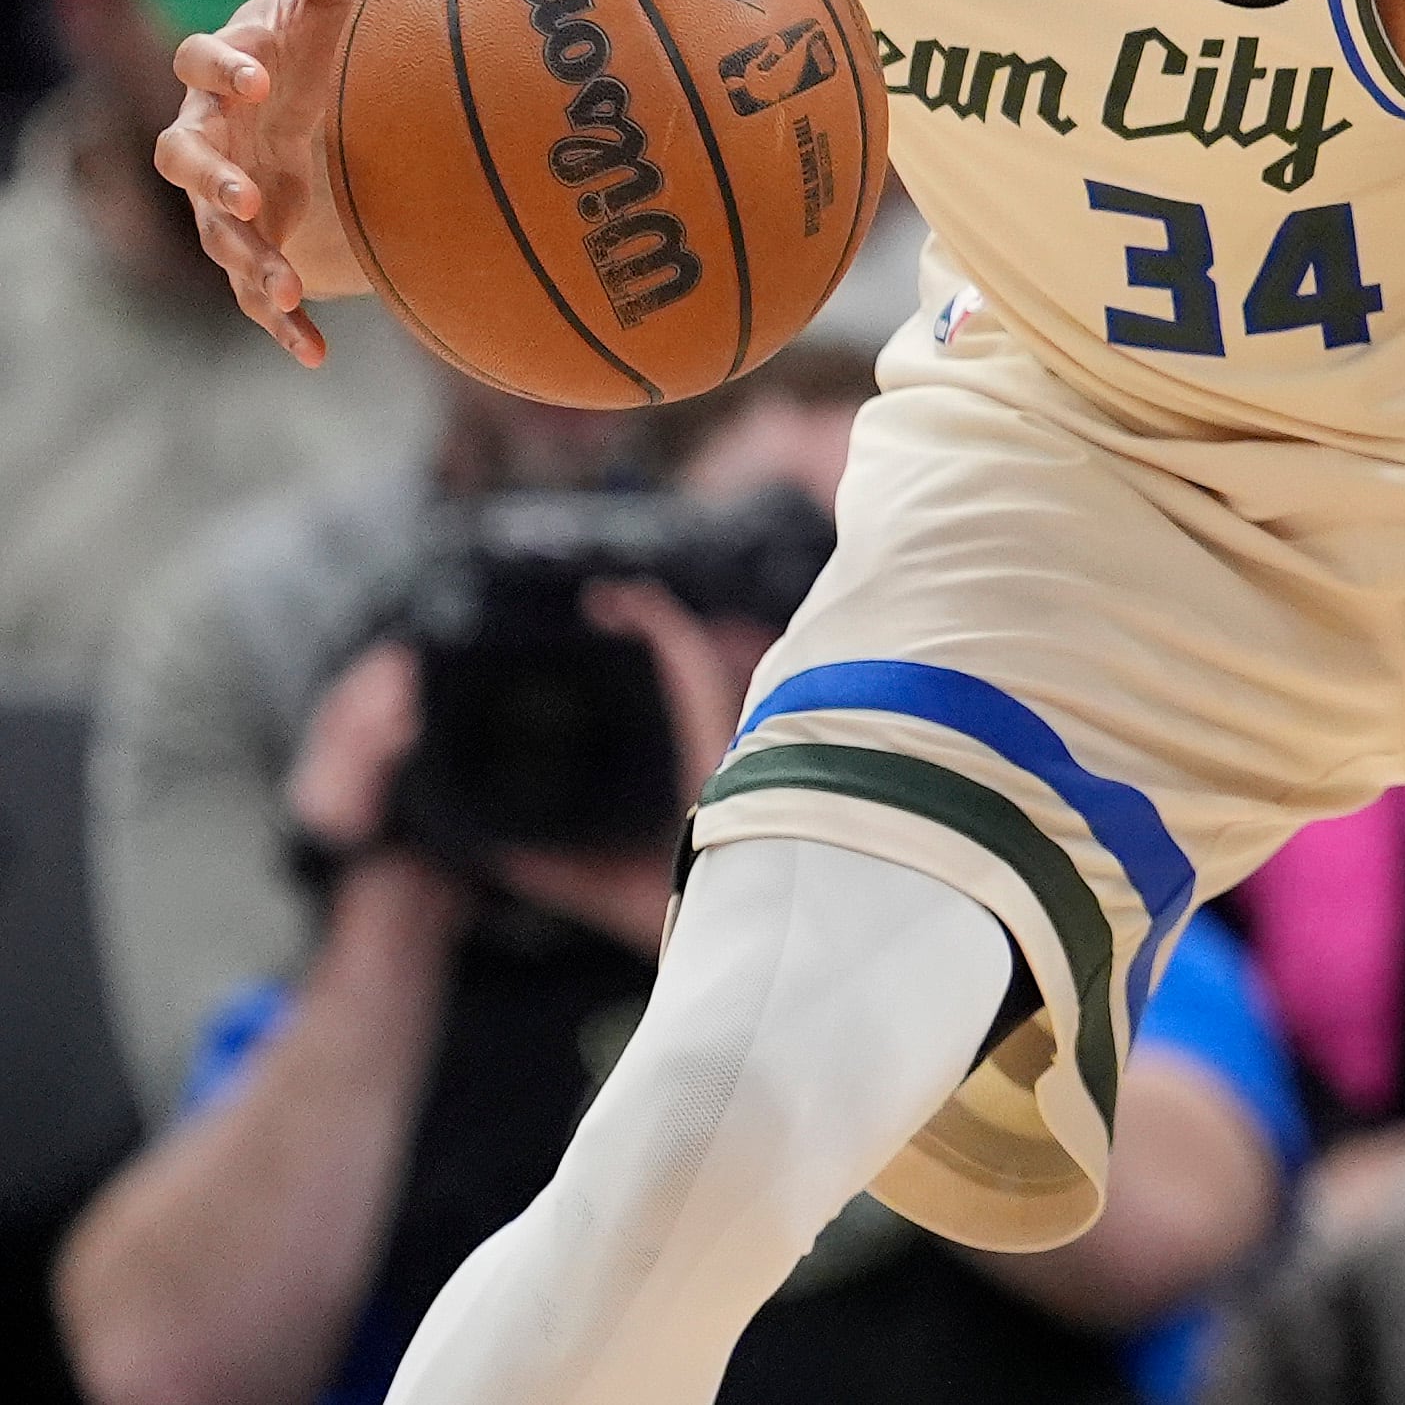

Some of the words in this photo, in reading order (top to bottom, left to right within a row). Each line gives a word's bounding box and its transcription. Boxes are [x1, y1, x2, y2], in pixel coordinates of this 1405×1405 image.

[873, 29, 1078, 136] eam
[1101, 26, 1353, 193] City
[1083, 178, 1384, 357] 34
